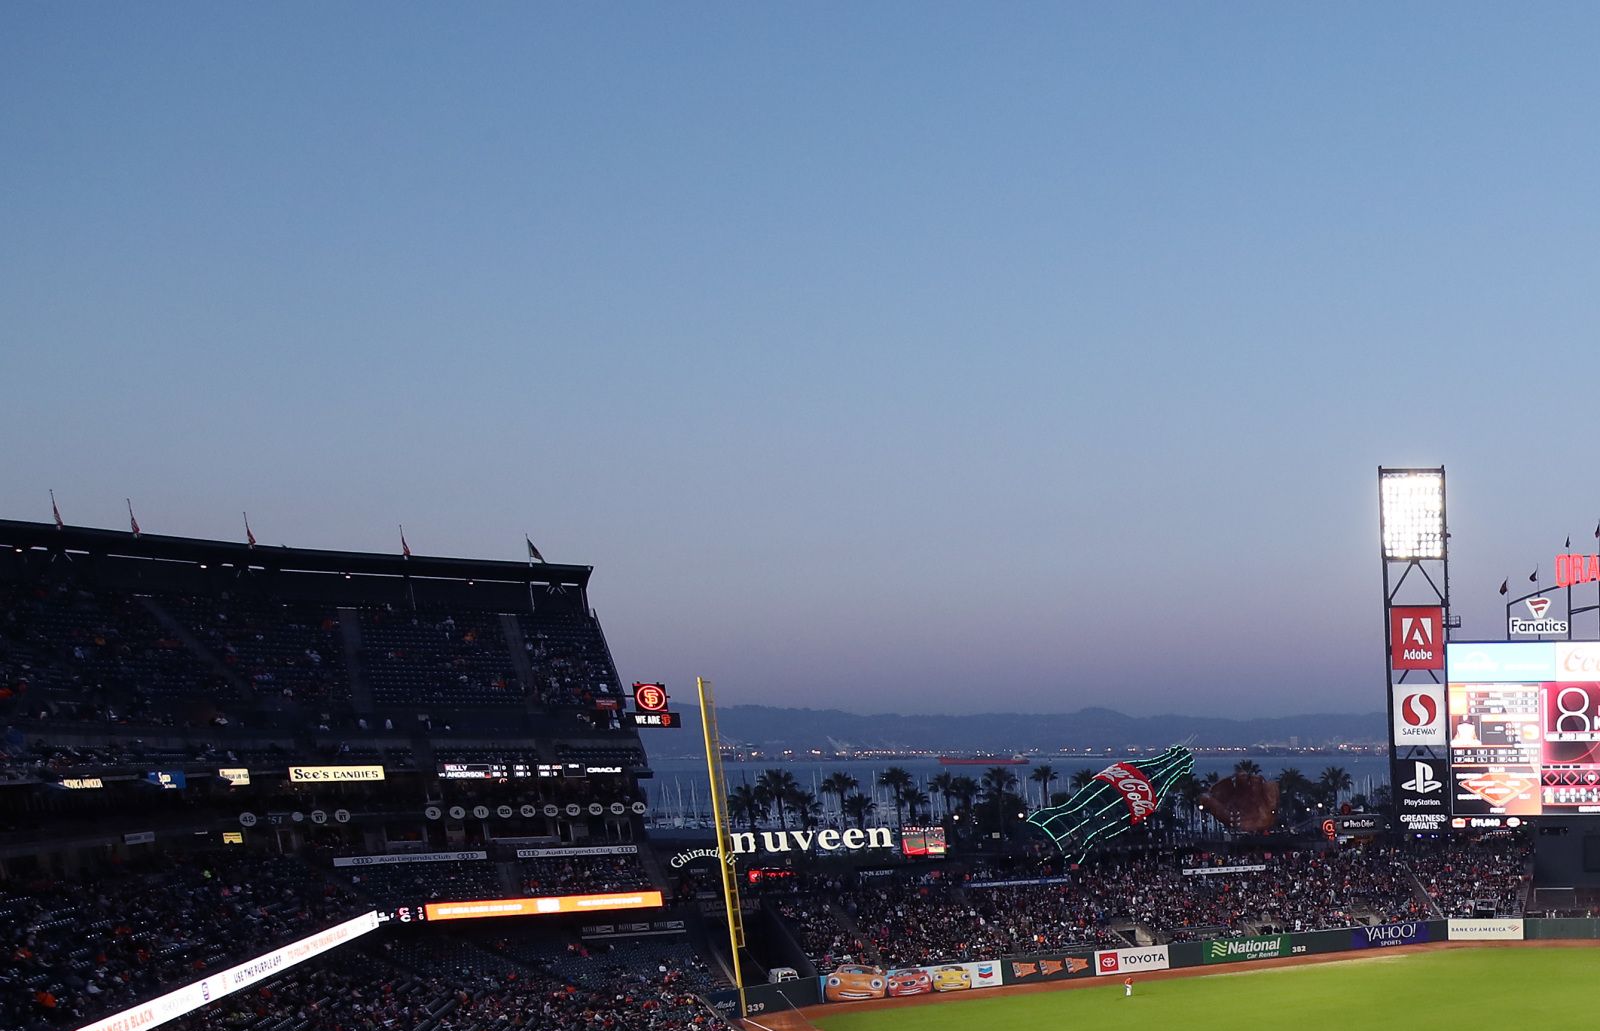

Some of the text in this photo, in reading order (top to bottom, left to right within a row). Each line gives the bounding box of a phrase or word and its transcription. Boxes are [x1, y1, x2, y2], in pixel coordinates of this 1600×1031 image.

[1511, 620, 1567, 632] Fanatics
[1403, 649, 1433, 660] Adobe
[635, 715, 647, 725] WE
[647, 715, 661, 725] ARE
[294, 768, 379, 780] See's CANDIES
[634, 804, 644, 812] 44
[1404, 799, 1441, 808] PlayStation
[523, 807, 533, 815] 24
[242, 815, 255, 823] 42
[1400, 814, 1446, 823] GREATNESS
[731, 826, 895, 855] nuveen
[1365, 923, 1417, 942] YAHOO!
[1227, 938, 1281, 955] National
[1122, 953, 1166, 965] TOYOTA
[1259, 951, 1280, 959] Rental
[130, 1008, 154, 1029] BLACK
